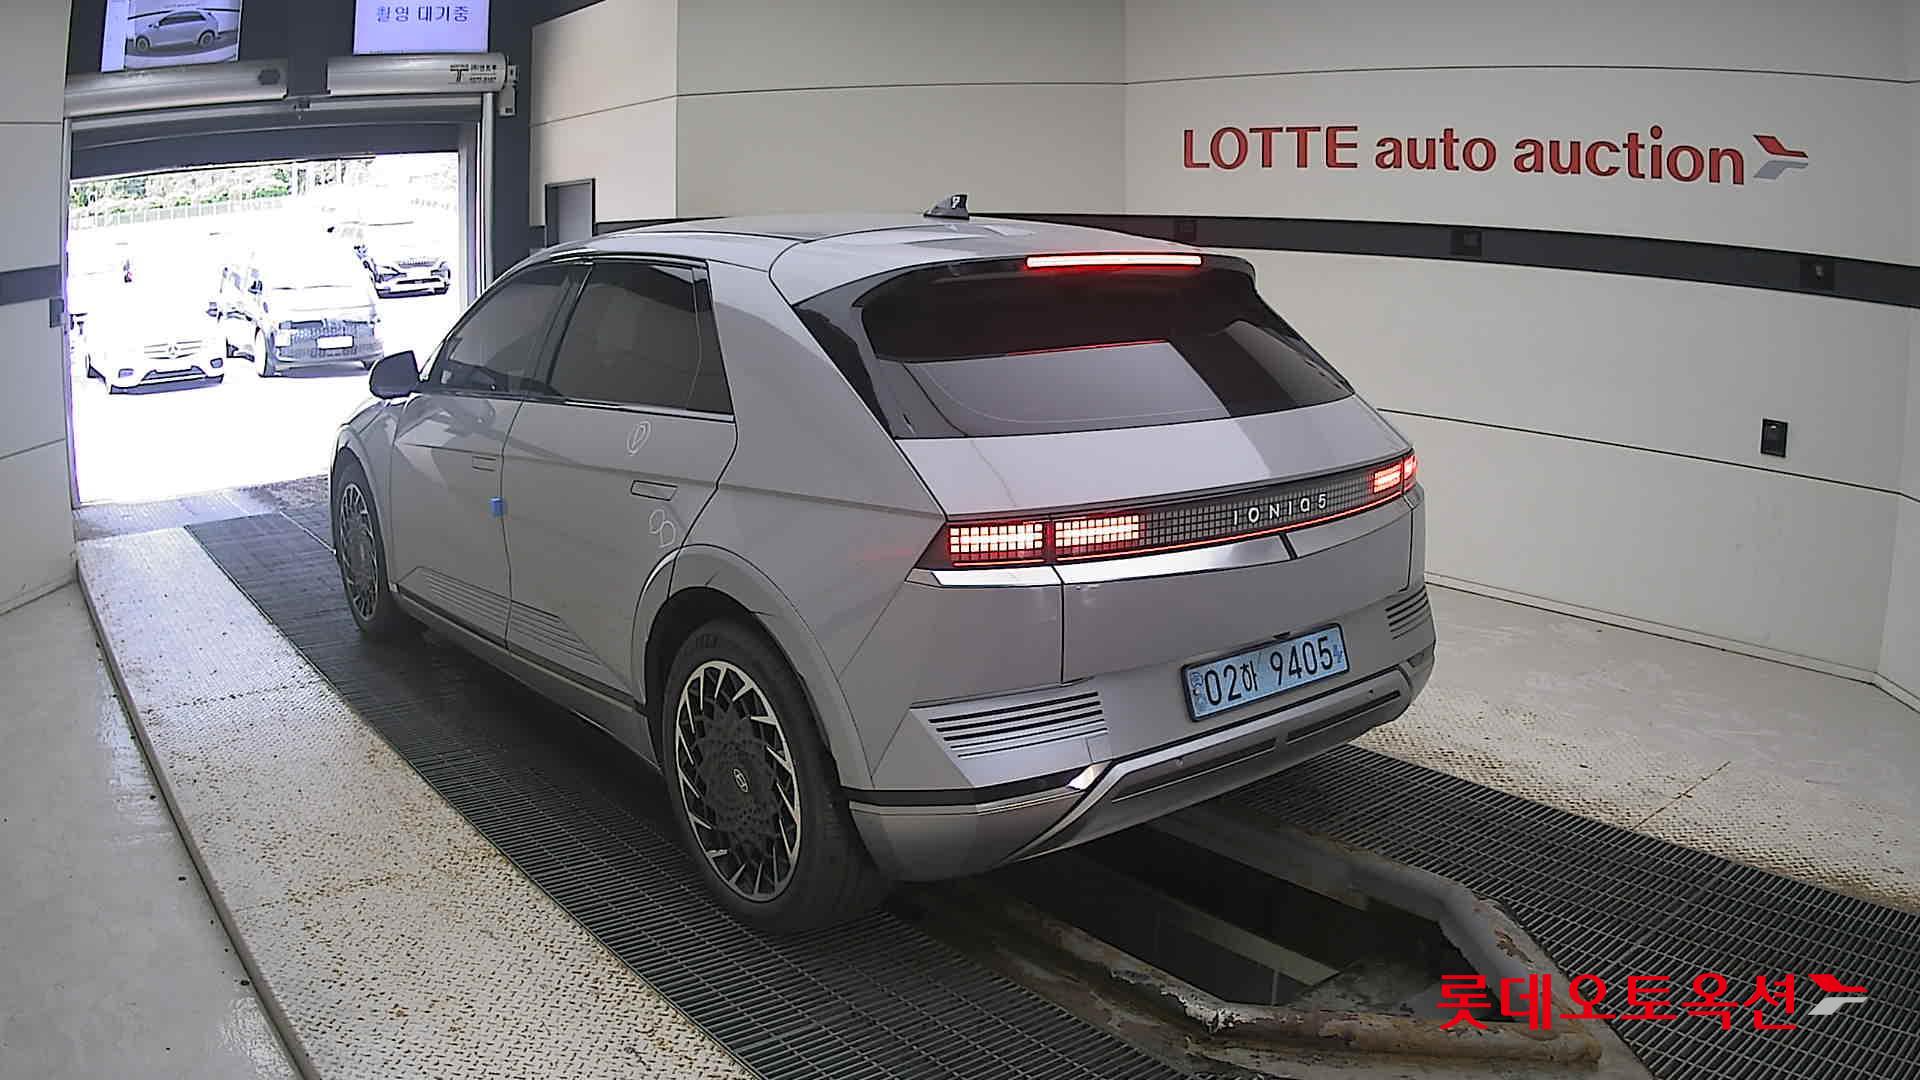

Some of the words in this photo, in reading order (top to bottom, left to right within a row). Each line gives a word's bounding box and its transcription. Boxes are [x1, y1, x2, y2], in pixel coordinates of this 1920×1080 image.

[418, 5, 470, 22] 대기중
[1184, 126, 1358, 170] LOTTE
[1375, 128, 1497, 171] auto
[1513, 125, 1744, 185] auction
[1204, 661, 1258, 706] 02하
[1270, 636, 1334, 687] 9405
